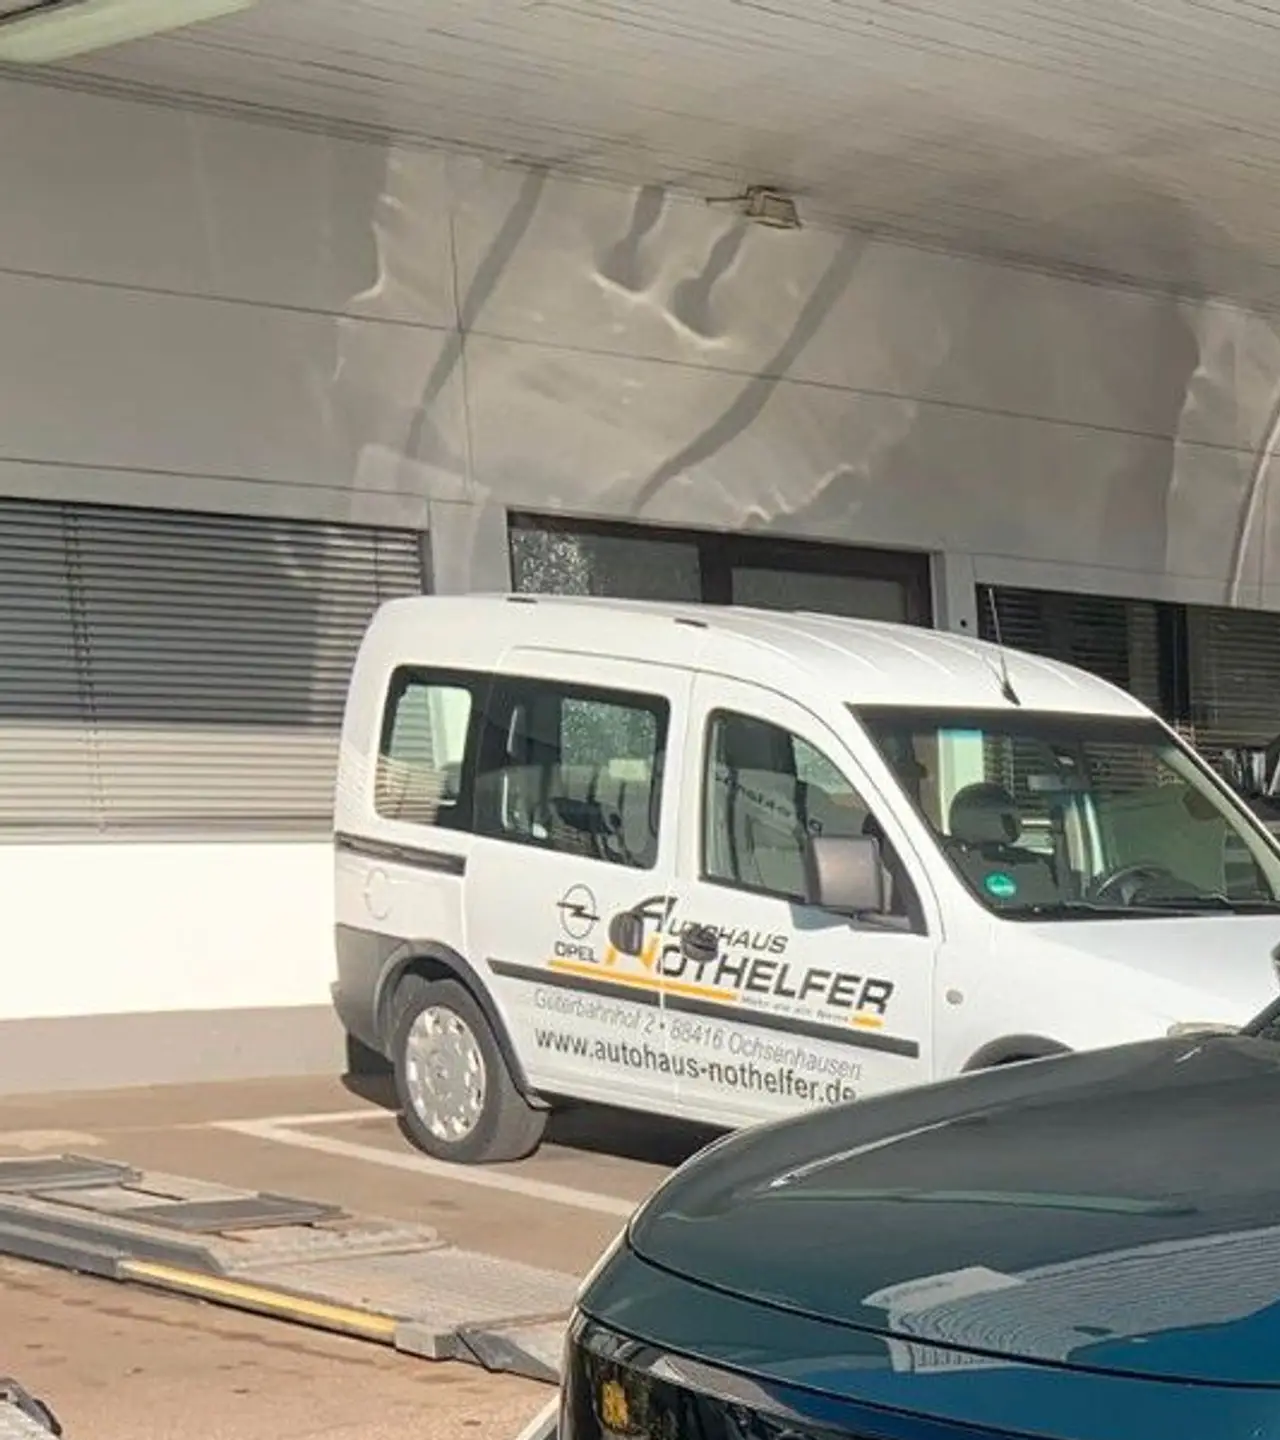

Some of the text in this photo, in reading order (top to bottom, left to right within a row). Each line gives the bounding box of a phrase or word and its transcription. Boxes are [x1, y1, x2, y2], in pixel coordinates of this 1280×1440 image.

[554, 940, 600, 964] OPEL
[642, 1012, 656, 1034] 2
[534, 1027, 857, 1104] www.autohaus-nothelfer.de
